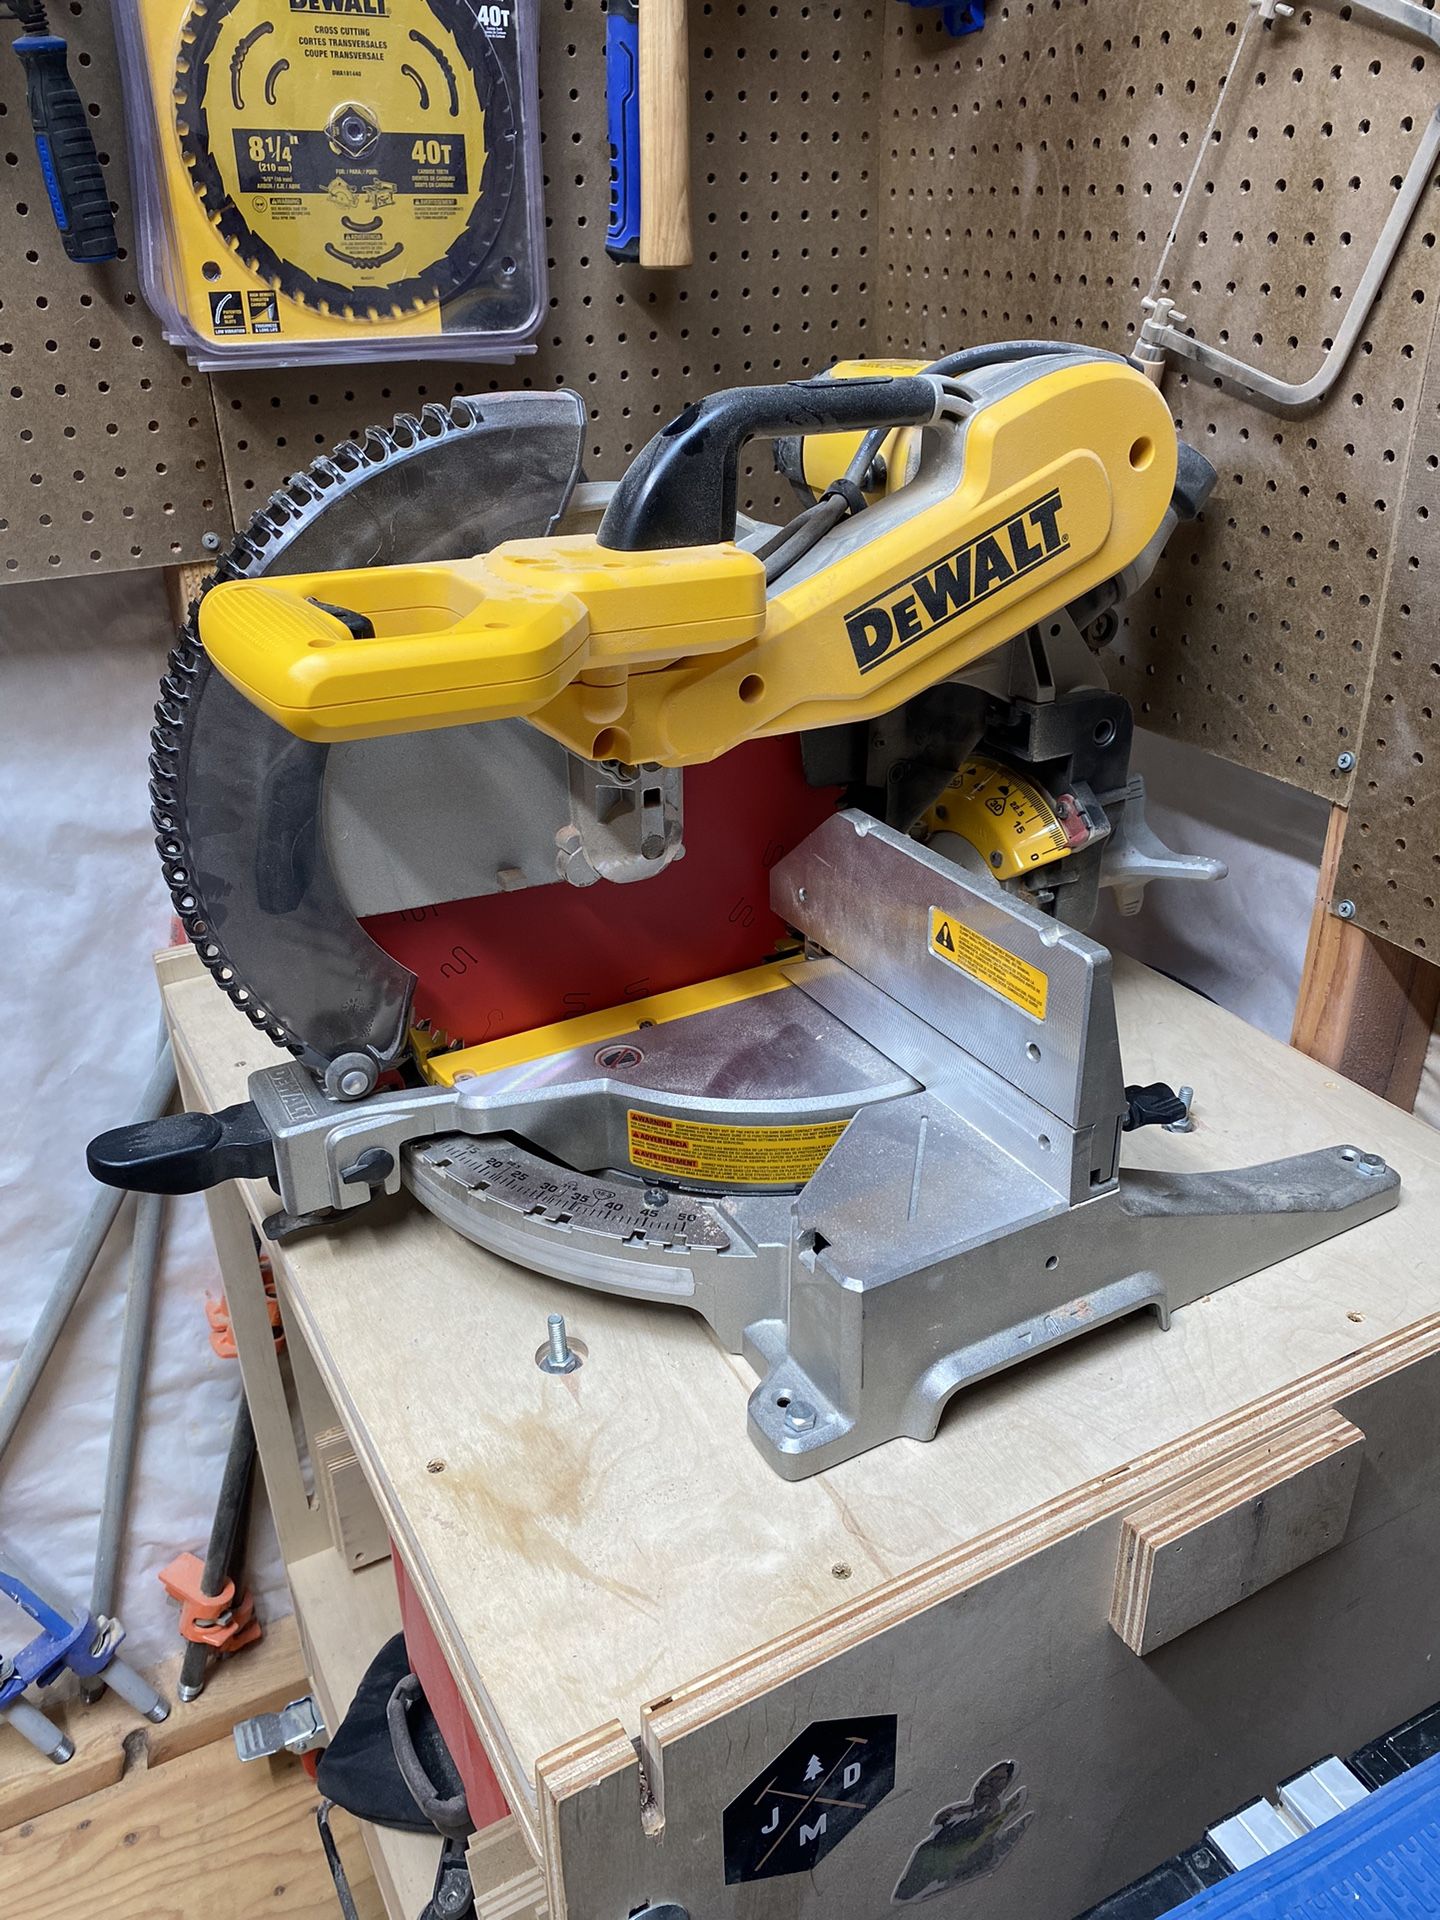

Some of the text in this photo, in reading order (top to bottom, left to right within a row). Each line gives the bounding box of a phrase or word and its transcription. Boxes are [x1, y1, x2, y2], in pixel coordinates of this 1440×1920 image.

[478, 5, 510, 27] 40T
[314, 25, 370, 36] CROSS CUTTING
[298, 36, 388, 49] CORTES TRANSVERSALES
[304, 49, 384, 61] COUPE TRANSVERSALE
[411, 139, 452, 165] 40T
[258, 161, 277, 173] (210
[845, 494, 1063, 669] DEWALT
[989, 800, 1002, 811] 30
[1009, 801, 1025, 817] 22.5
[1013, 820, 1026, 835] 15
[1030, 853, 1040, 862] 0
[639, 1114, 673, 1129] WARNING
[640, 1133, 689, 1148] ADVERTENCIA
[485, 1157, 503, 1169] 20
[640, 1150, 698, 1168] AVERTISSEMENT
[510, 1170, 529, 1181] 25
[539, 1182, 558, 1193] 30
[570, 1192, 590, 1203] 35
[604, 1202, 624, 1212] 40
[639, 1208, 659, 1218] 45
[677, 1212, 697, 1222] 50
[843, 1762, 861, 1790] D
[761, 1806, 780, 1834] J
[800, 1812, 827, 1847] M
